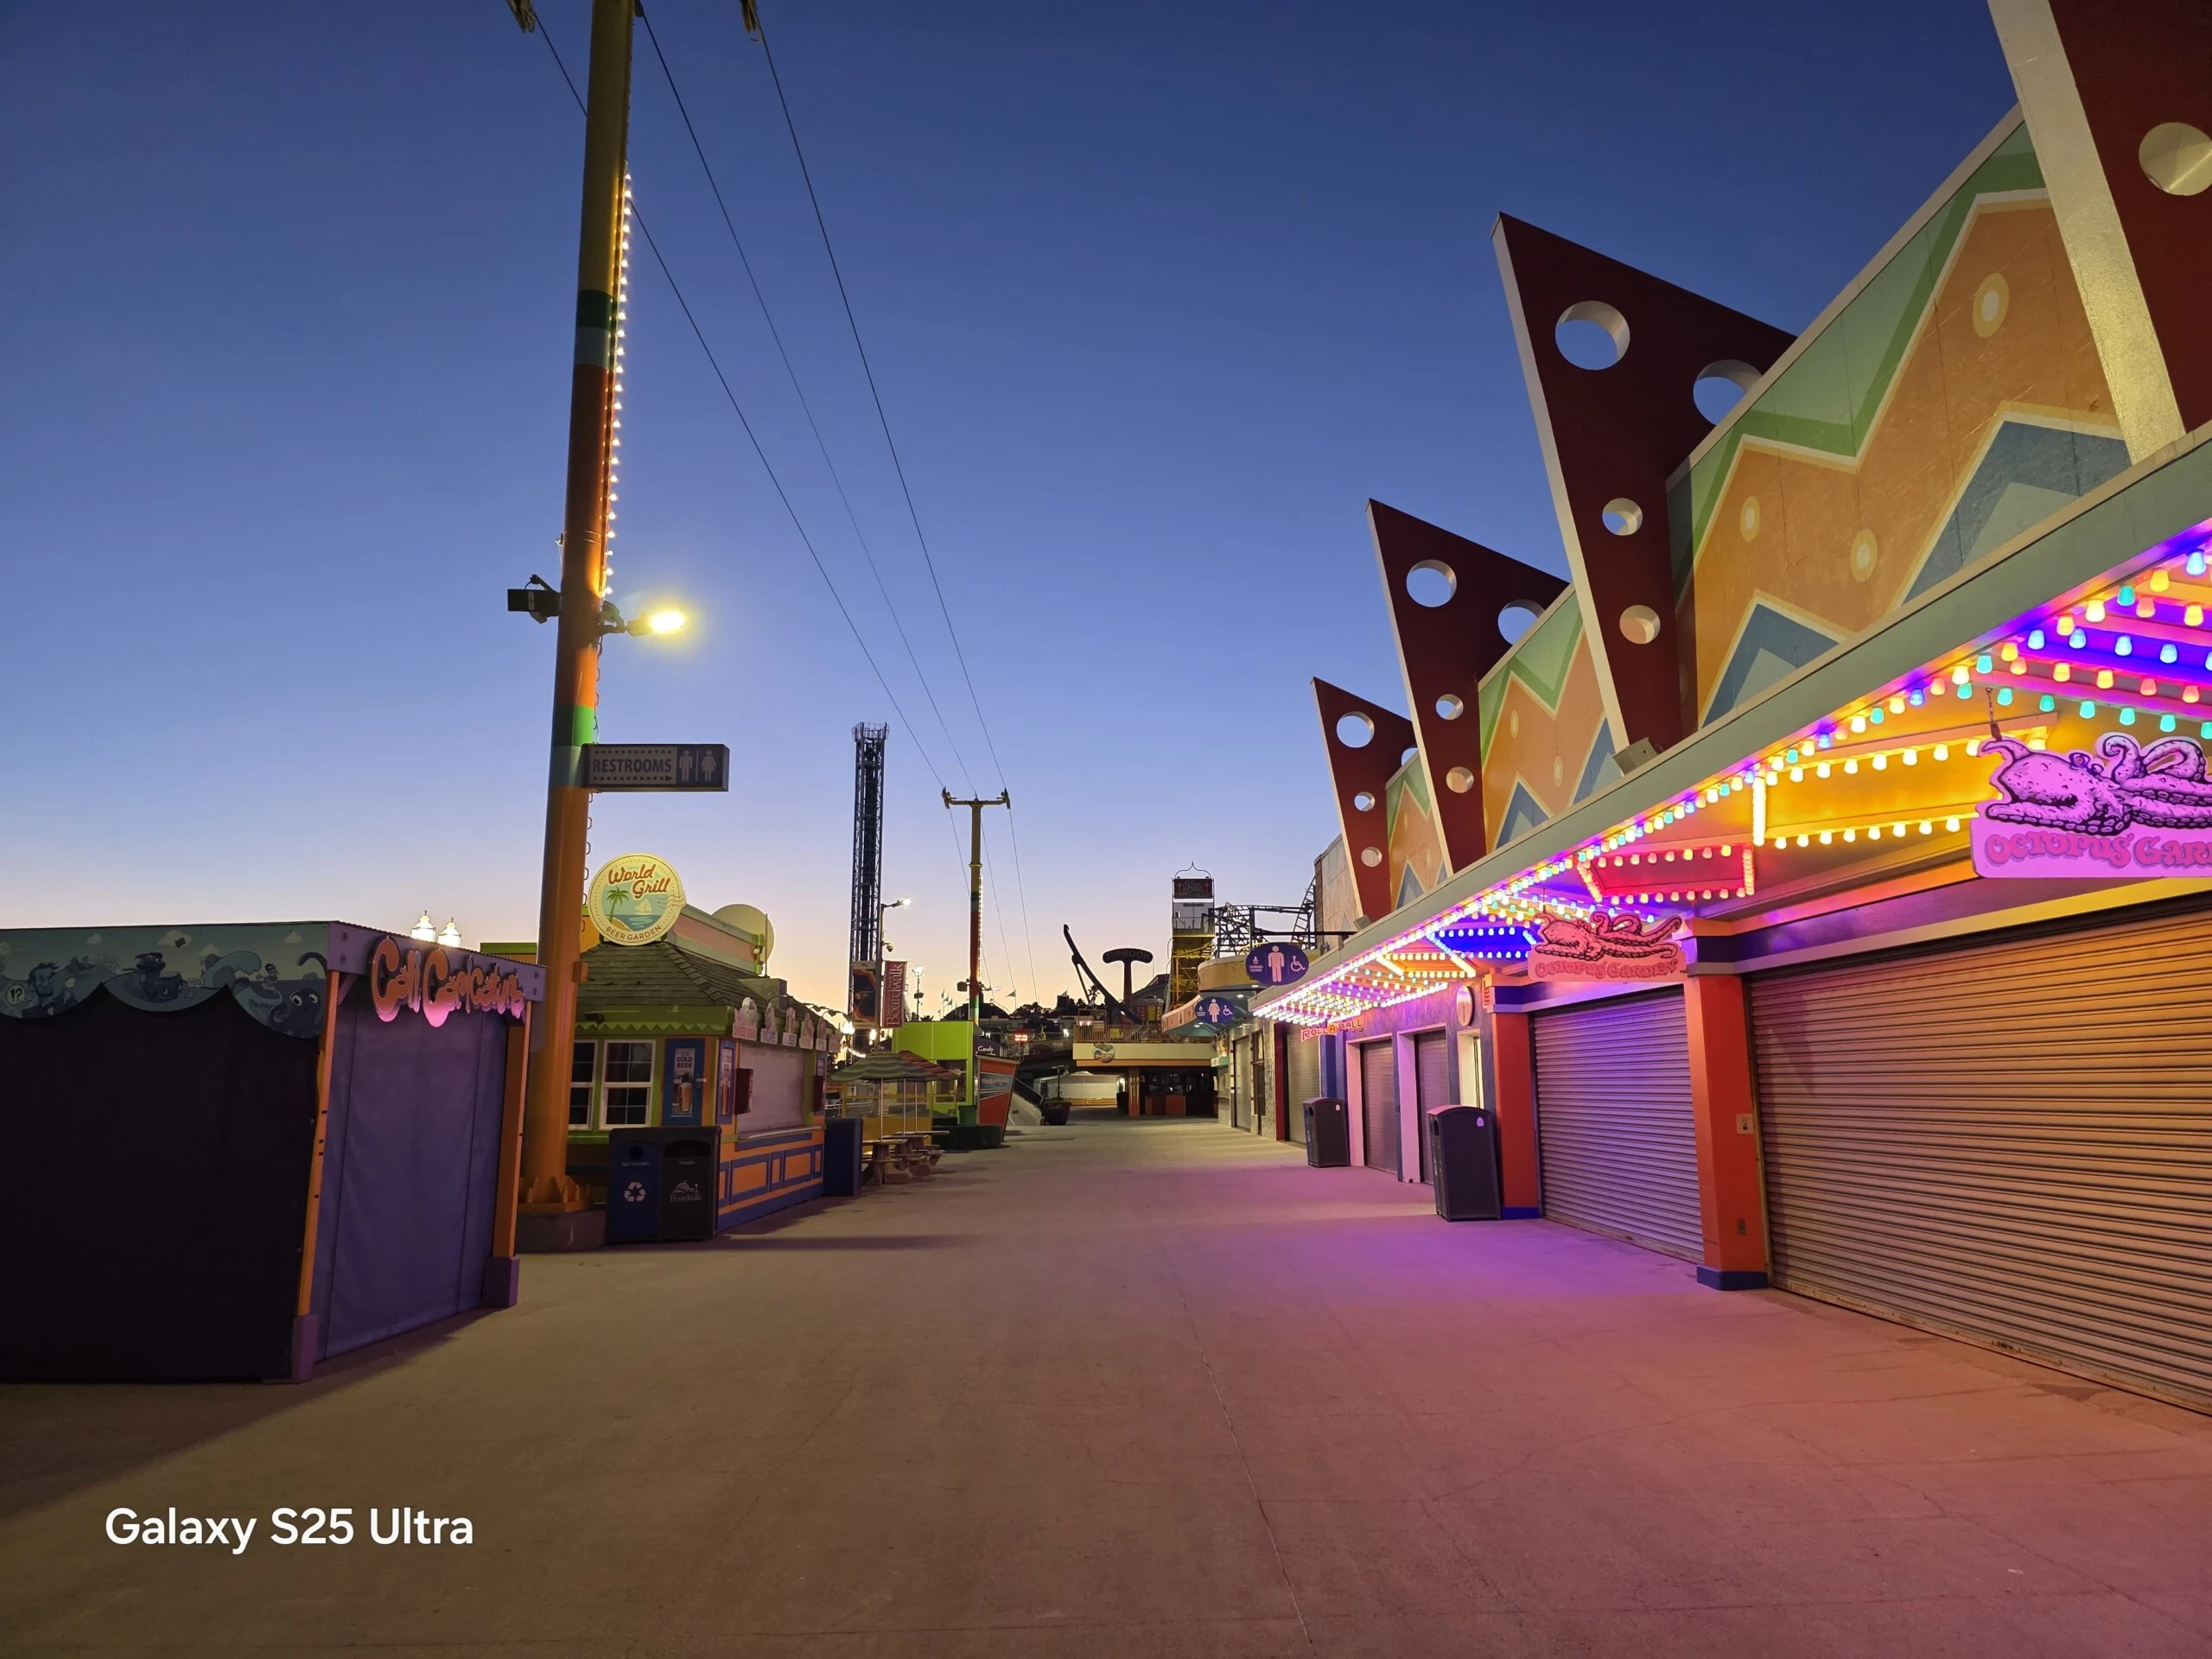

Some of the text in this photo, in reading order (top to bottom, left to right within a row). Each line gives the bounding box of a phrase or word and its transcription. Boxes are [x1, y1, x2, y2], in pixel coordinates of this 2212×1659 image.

[592, 758, 672, 773] RESTROOMS
[2133, 836, 2212, 868] GAR
[608, 863, 657, 885] World
[632, 878, 671, 899] Grill
[606, 925, 662, 940] BEER GARDEN
[372, 936, 422, 1022] Cali
[886, 963, 903, 1027] Boardwalk
[1302, 1028, 1329, 1040] ROLL
[1338, 1020, 1363, 1029] BALL
[977, 1046, 995, 1056] Candy
